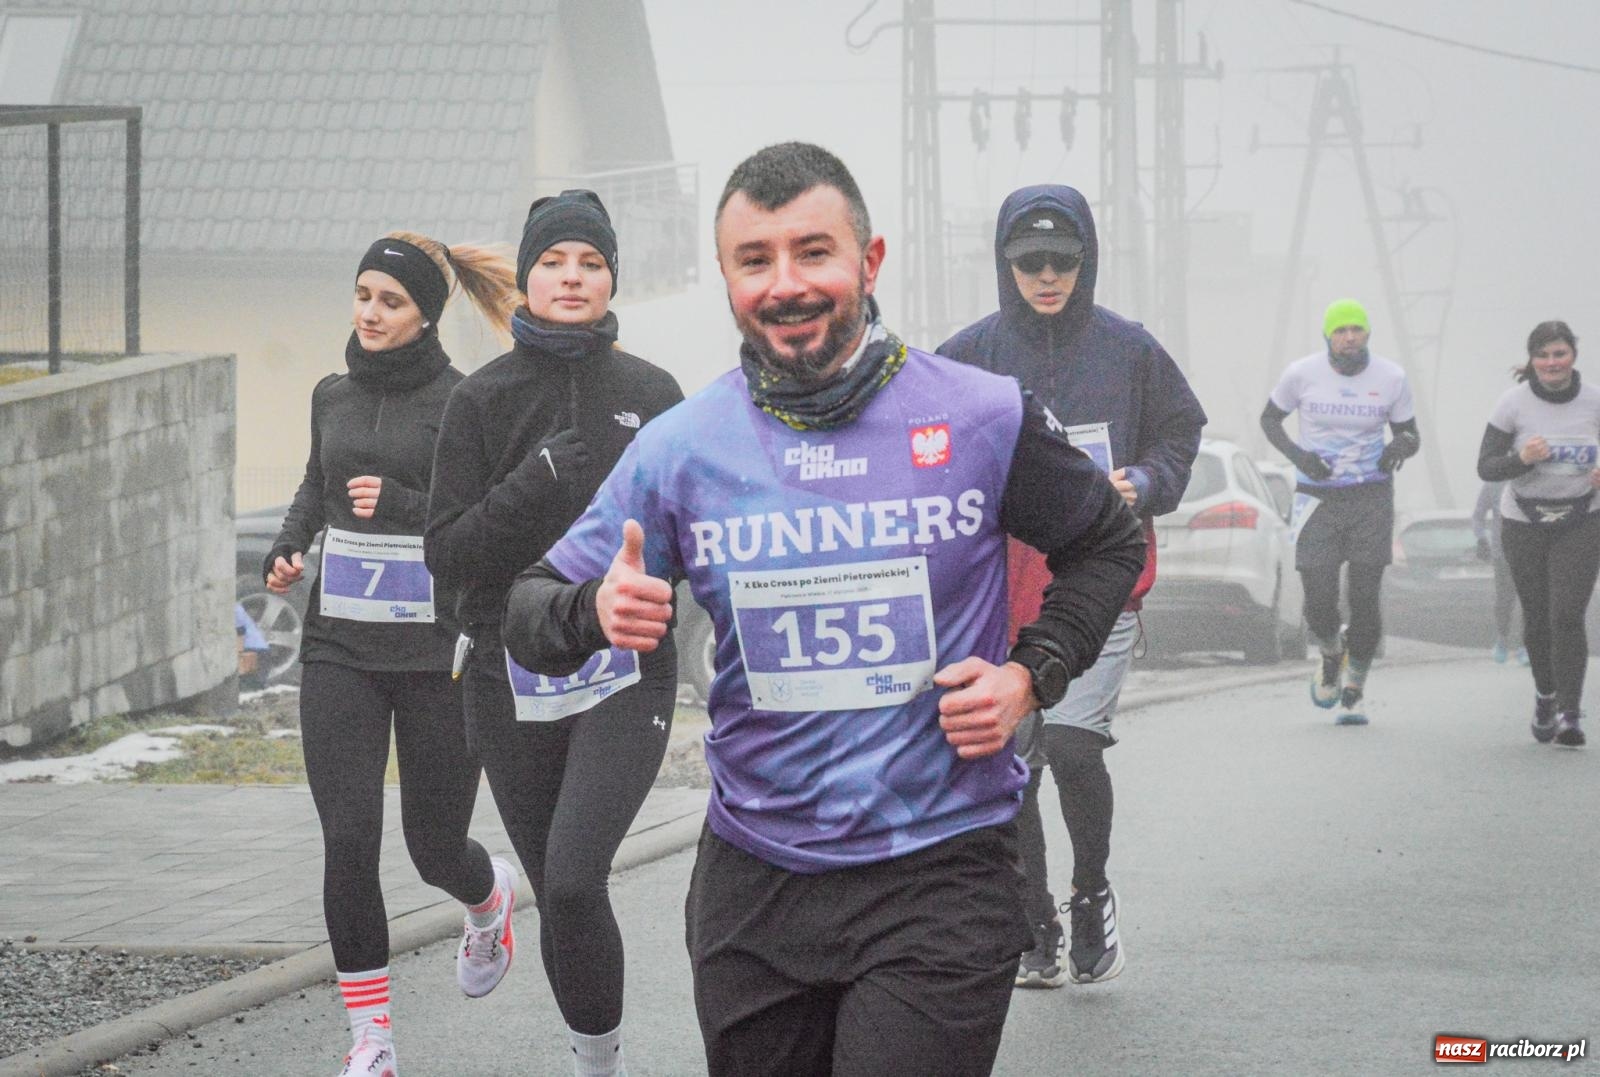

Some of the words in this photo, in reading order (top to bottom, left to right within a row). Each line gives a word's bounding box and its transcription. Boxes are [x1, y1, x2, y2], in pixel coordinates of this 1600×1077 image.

[907, 412, 950, 424] POLAND
[1551, 446, 1589, 464] 126
[690, 489, 985, 567] RUNNERS
[361, 561, 385, 597] 7
[752, 580, 769, 589] Eko
[770, 579, 798, 588] Cross
[799, 578, 812, 588] po
[814, 573, 842, 585] Ziemi
[843, 567, 910, 582] Pietrowickiej
[771, 603, 896, 668] 155
